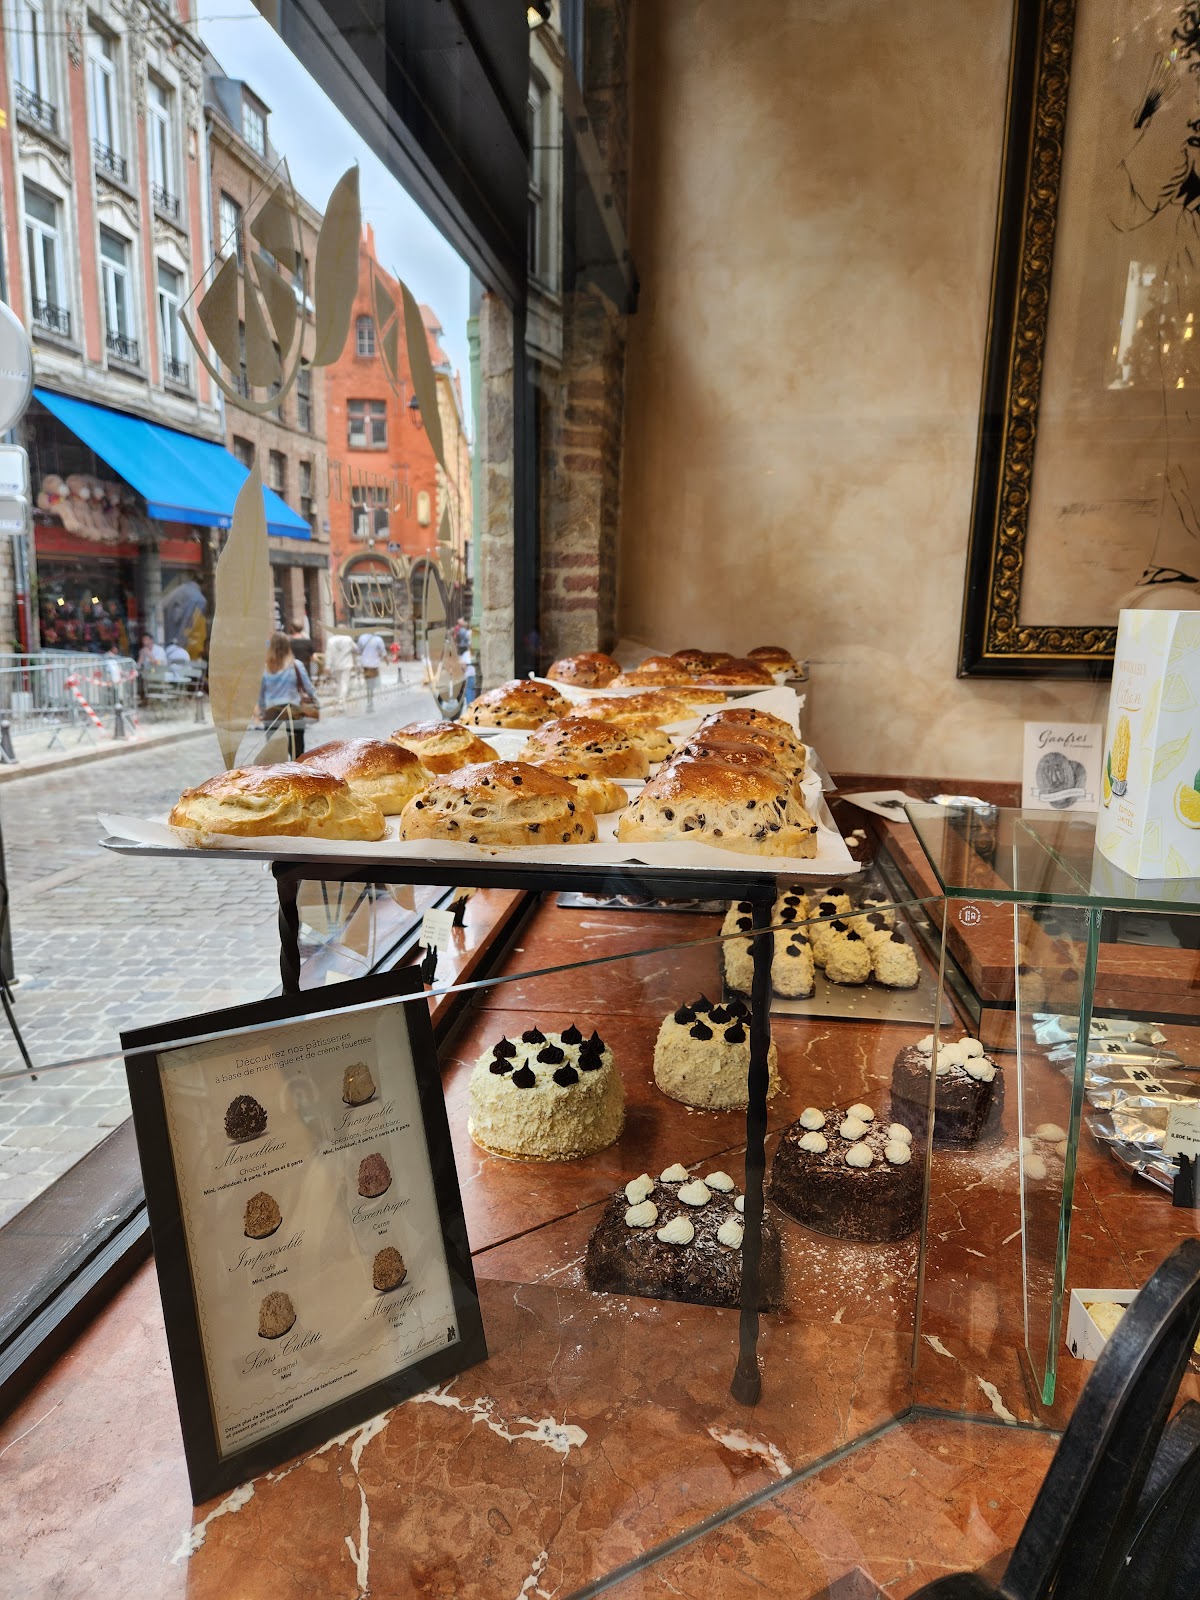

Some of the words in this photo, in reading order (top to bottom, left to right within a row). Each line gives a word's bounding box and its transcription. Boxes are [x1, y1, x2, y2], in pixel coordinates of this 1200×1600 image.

[1037, 729, 1088, 749] Gaufres
[215, 1076, 221, 1084] à
[221, 1072, 242, 1082] base
[243, 1067, 255, 1076] de
[256, 1057, 294, 1073] meringue
[295, 1054, 304, 1062] et
[305, 1051, 316, 1060] de
[317, 1045, 341, 1056] crème
[341, 1036, 372, 1050] fouettée
[235, 1049, 286, 1069] Découvrez
[287, 1045, 304, 1056] nos
[305, 1032, 352, 1053] pâtisseries
[333, 1099, 397, 1132] Incroyable
[214, 1137, 287, 1170] Merveilleux
[203, 1187, 216, 1196] Mini,
[267, 1166, 280, 1175] parts
[239, 1162, 268, 1176] Chocolat
[351, 1198, 411, 1225] Excentrique
[228, 1229, 306, 1273] Impensable
[261, 1262, 276, 1273] Café
[364, 1286, 426, 1320] Magnifique
[271, 1359, 298, 1376] Caramel
[280, 1371, 292, 1381] Mini
